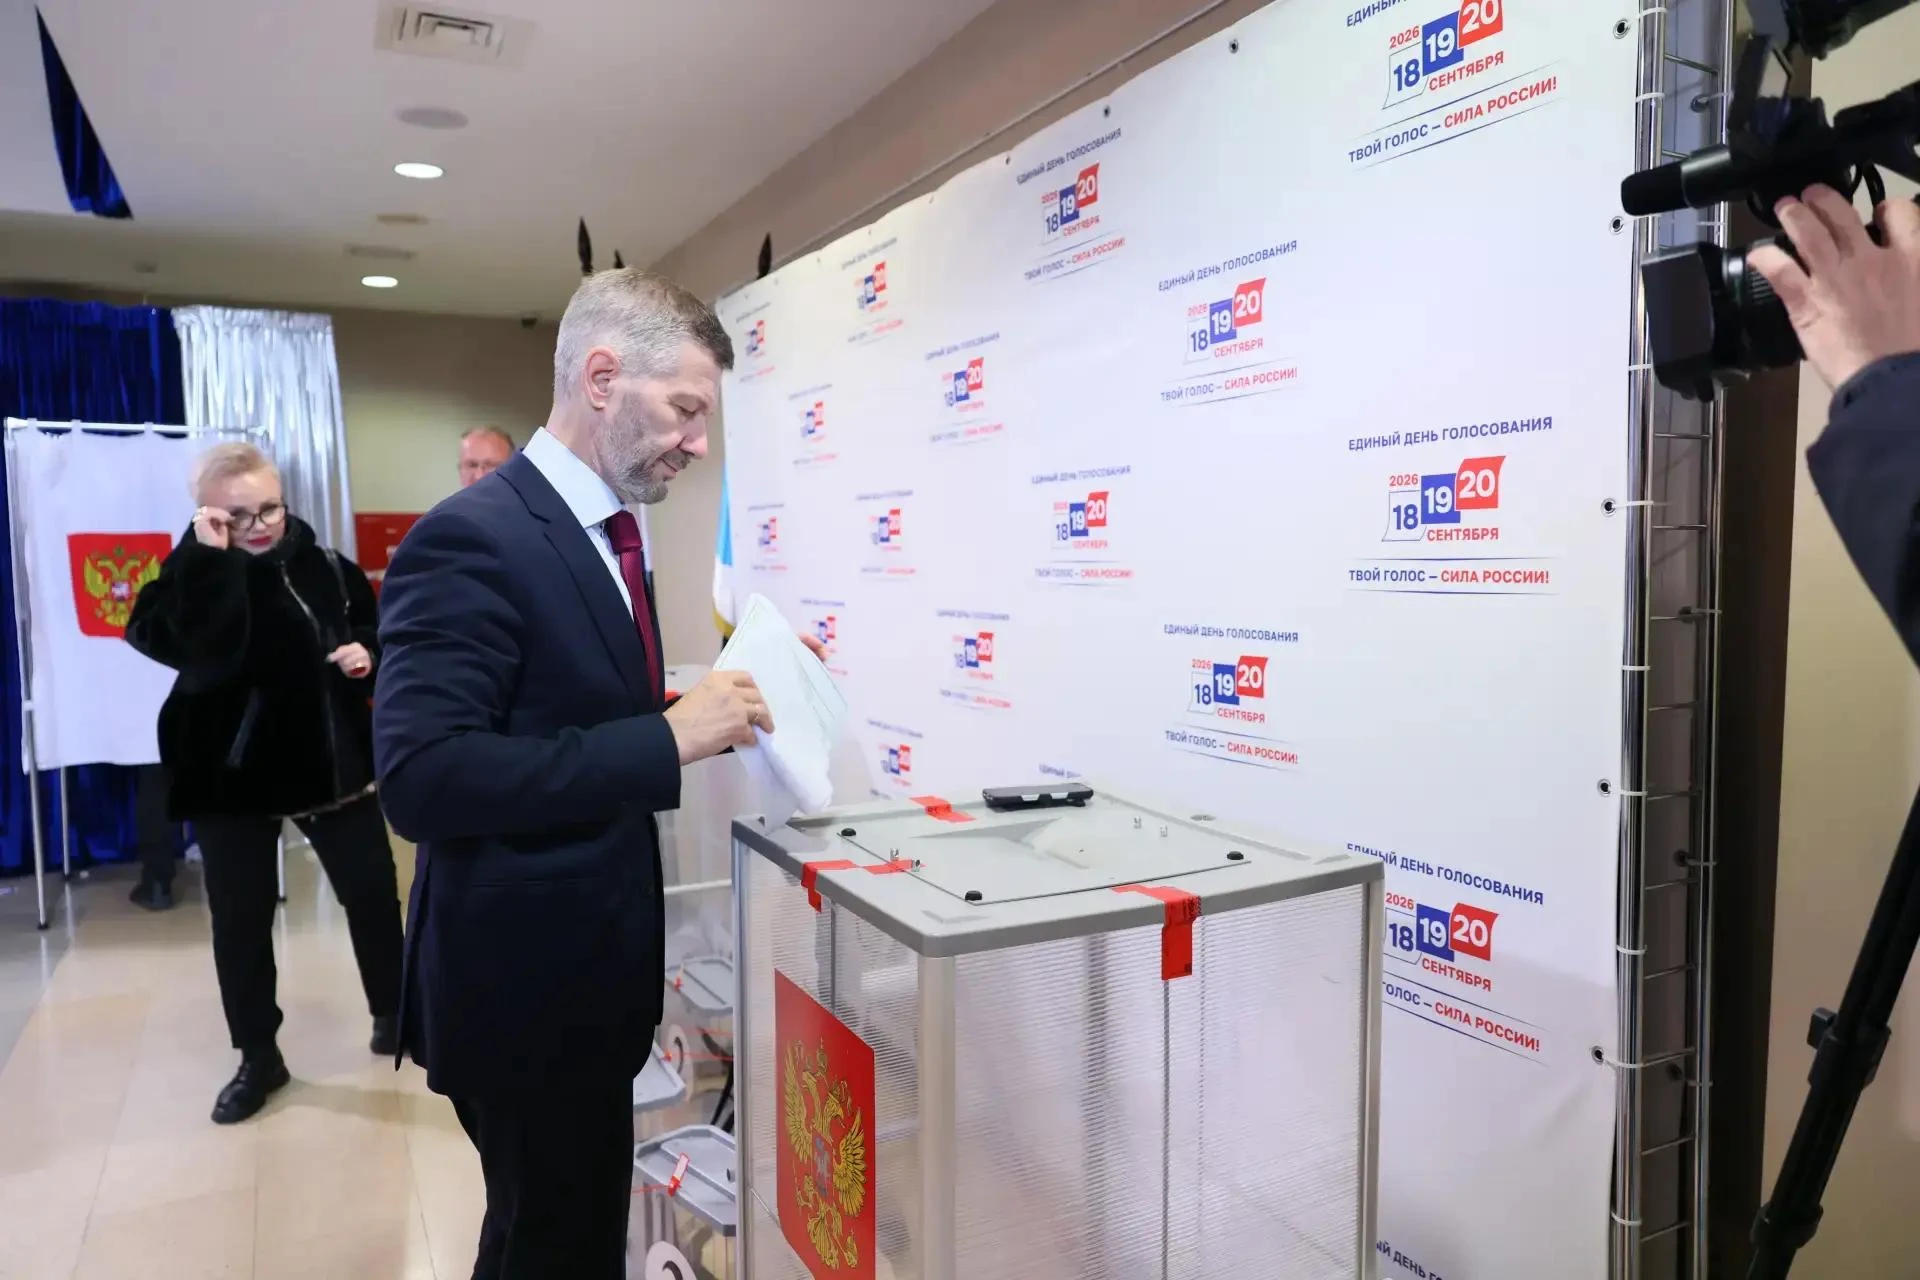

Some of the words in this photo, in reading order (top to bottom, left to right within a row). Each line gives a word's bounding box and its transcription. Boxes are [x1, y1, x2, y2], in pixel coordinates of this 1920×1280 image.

[1347, 0, 1406, 27] ЕДИНЫ
[1389, 26, 1420, 49] 2026
[1393, 58, 1420, 92] 18
[1425, 27, 1456, 63] 19
[1462, 0, 1500, 35] 20
[1429, 51, 1505, 91] СЕНТЯБРЯ
[1349, 139, 1382, 163] ТВОЙ
[1385, 124, 1428, 151] ГОЛОС
[1444, 103, 1484, 129] СИЛА
[1488, 76, 1557, 113] РОССИИ!
[1046, 214, 1059, 235] 18
[1060, 194, 1075, 217] 19
[1077, 175, 1096, 200] 20
[1158, 270, 1195, 292] ЕДИНЫЙ
[1197, 264, 1221, 281] ДЕНЬ
[1223, 240, 1298, 272] ГОЛОСОВАНИЯ
[1190, 329, 1208, 353] 18
[1211, 309, 1233, 336] 19
[1235, 290, 1261, 318] 20
[1214, 338, 1264, 358] СЕНТЯБРЯ
[1161, 389, 1184, 402] ТВОЙ
[1185, 383, 1215, 399] ГОЛОС
[1224, 378, 1250, 391] СИЛА
[1252, 367, 1298, 385] РОССИИ!
[1349, 431, 1400, 451] ЕДИНЫЙ
[1404, 430, 1439, 446] ДЕНЬ
[1442, 416, 1553, 441] ГОЛОСОВАНИЯ
[1389, 474, 1419, 487] 2026
[1392, 504, 1419, 530] 18
[1424, 486, 1453, 514] 19
[1459, 469, 1496, 498] 20
[1056, 523, 1069, 540] 18
[1070, 510, 1085, 531] 19
[1087, 499, 1106, 520] 20
[1427, 528, 1499, 542] СЕНТЯБРЯ
[1349, 567, 1381, 582] ТВОЙ
[1384, 570, 1426, 582] ГОЛОС
[1440, 570, 1479, 583] СИЛА
[1483, 570, 1550, 584] РОССИИ!
[1164, 623, 1198, 635] ЕДИНЫЙ
[1201, 627, 1224, 637] ДЕНЬ
[1226, 628, 1298, 643] ГОЛОСОВАНИЯ
[1194, 683, 1212, 706] 18
[1214, 673, 1235, 697] 19
[1238, 665, 1262, 689] 20
[1217, 707, 1265, 723] СЕНТЯБРЯ
[1165, 729, 1187, 743] ТВОЙ
[1188, 735, 1217, 749] ГОЛОС
[1227, 742, 1253, 756] СИЛА
[1255, 747, 1299, 765] РОССИИ!
[1400, 856, 1433, 875] ДЕНЬ
[1437, 866, 1544, 905] ГОЛОСОВАНИЯ
[1386, 893, 1414, 910] 2026
[1389, 922, 1414, 951] 18
[1419, 917, 1447, 948] 19
[1453, 914, 1488, 947] 20
[1422, 957, 1492, 992] СЕНТЯБРЯ
[1382, 981, 1421, 1005] ОЛОС
[1435, 1001, 1472, 1027] СИЛА
[1476, 1016, 1540, 1052] РОССИИ!
[1393, 1250, 1426, 1278] ДЕНЬ
